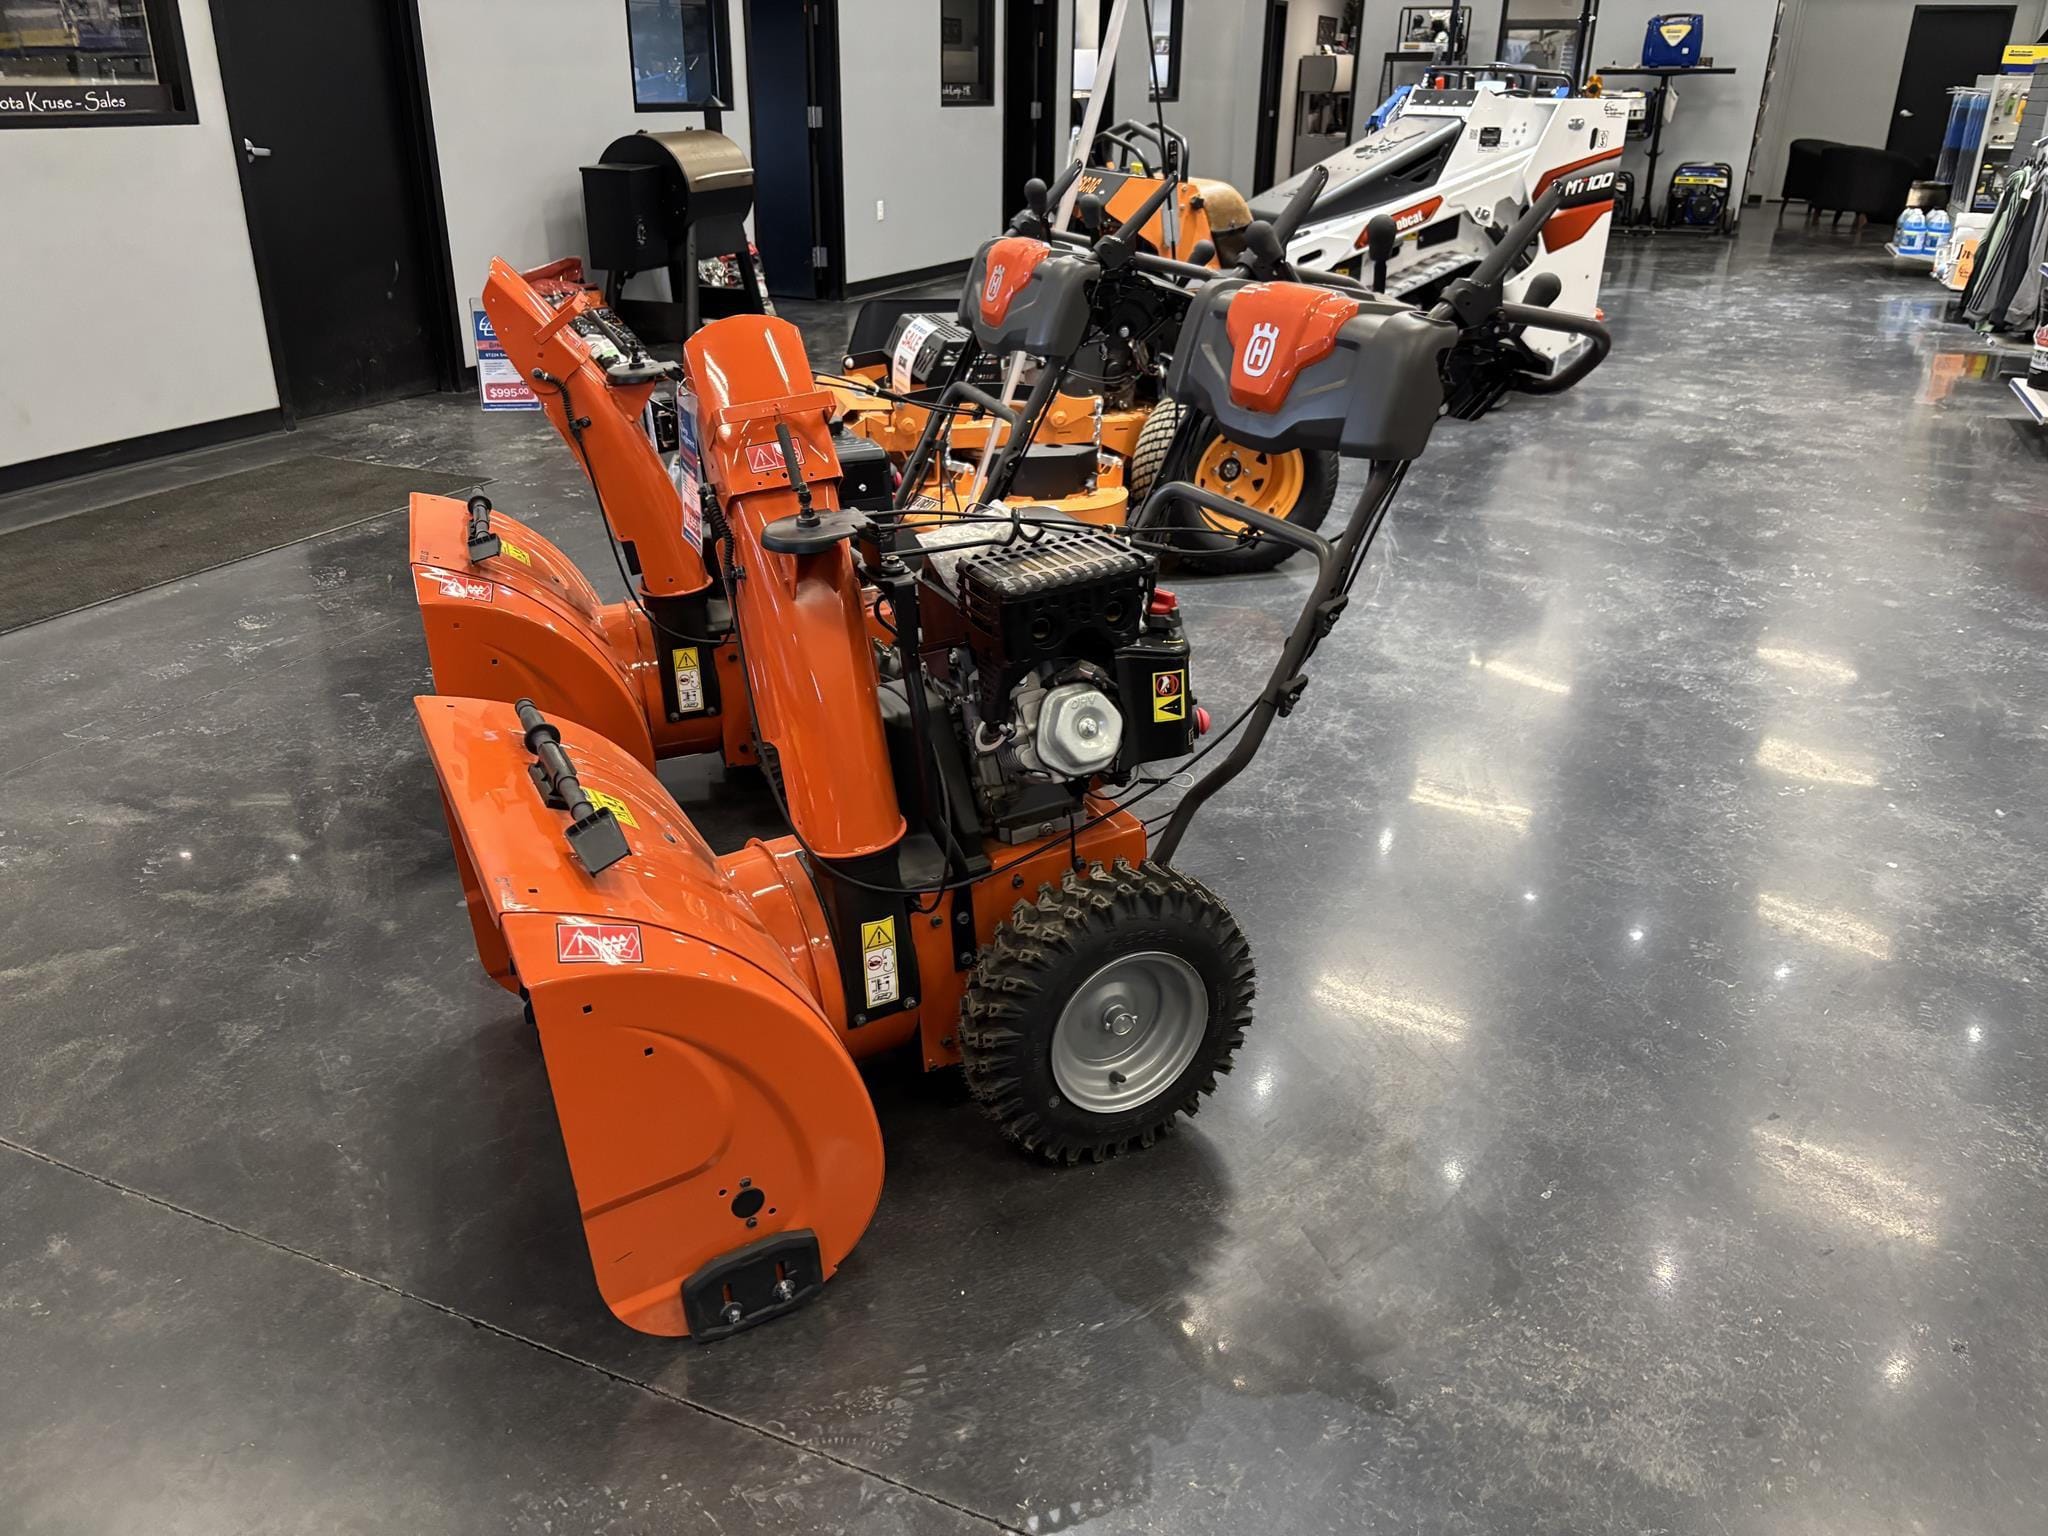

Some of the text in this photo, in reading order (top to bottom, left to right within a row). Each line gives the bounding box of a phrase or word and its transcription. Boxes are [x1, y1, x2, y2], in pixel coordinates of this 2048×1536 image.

[25, 91, 73, 112] Kruse
[84, 91, 126, 111] Sales
[1395, 209, 1424, 231] obcat
[489, 387, 529, 398] $995.00
[1070, 693, 1097, 709] OHV
